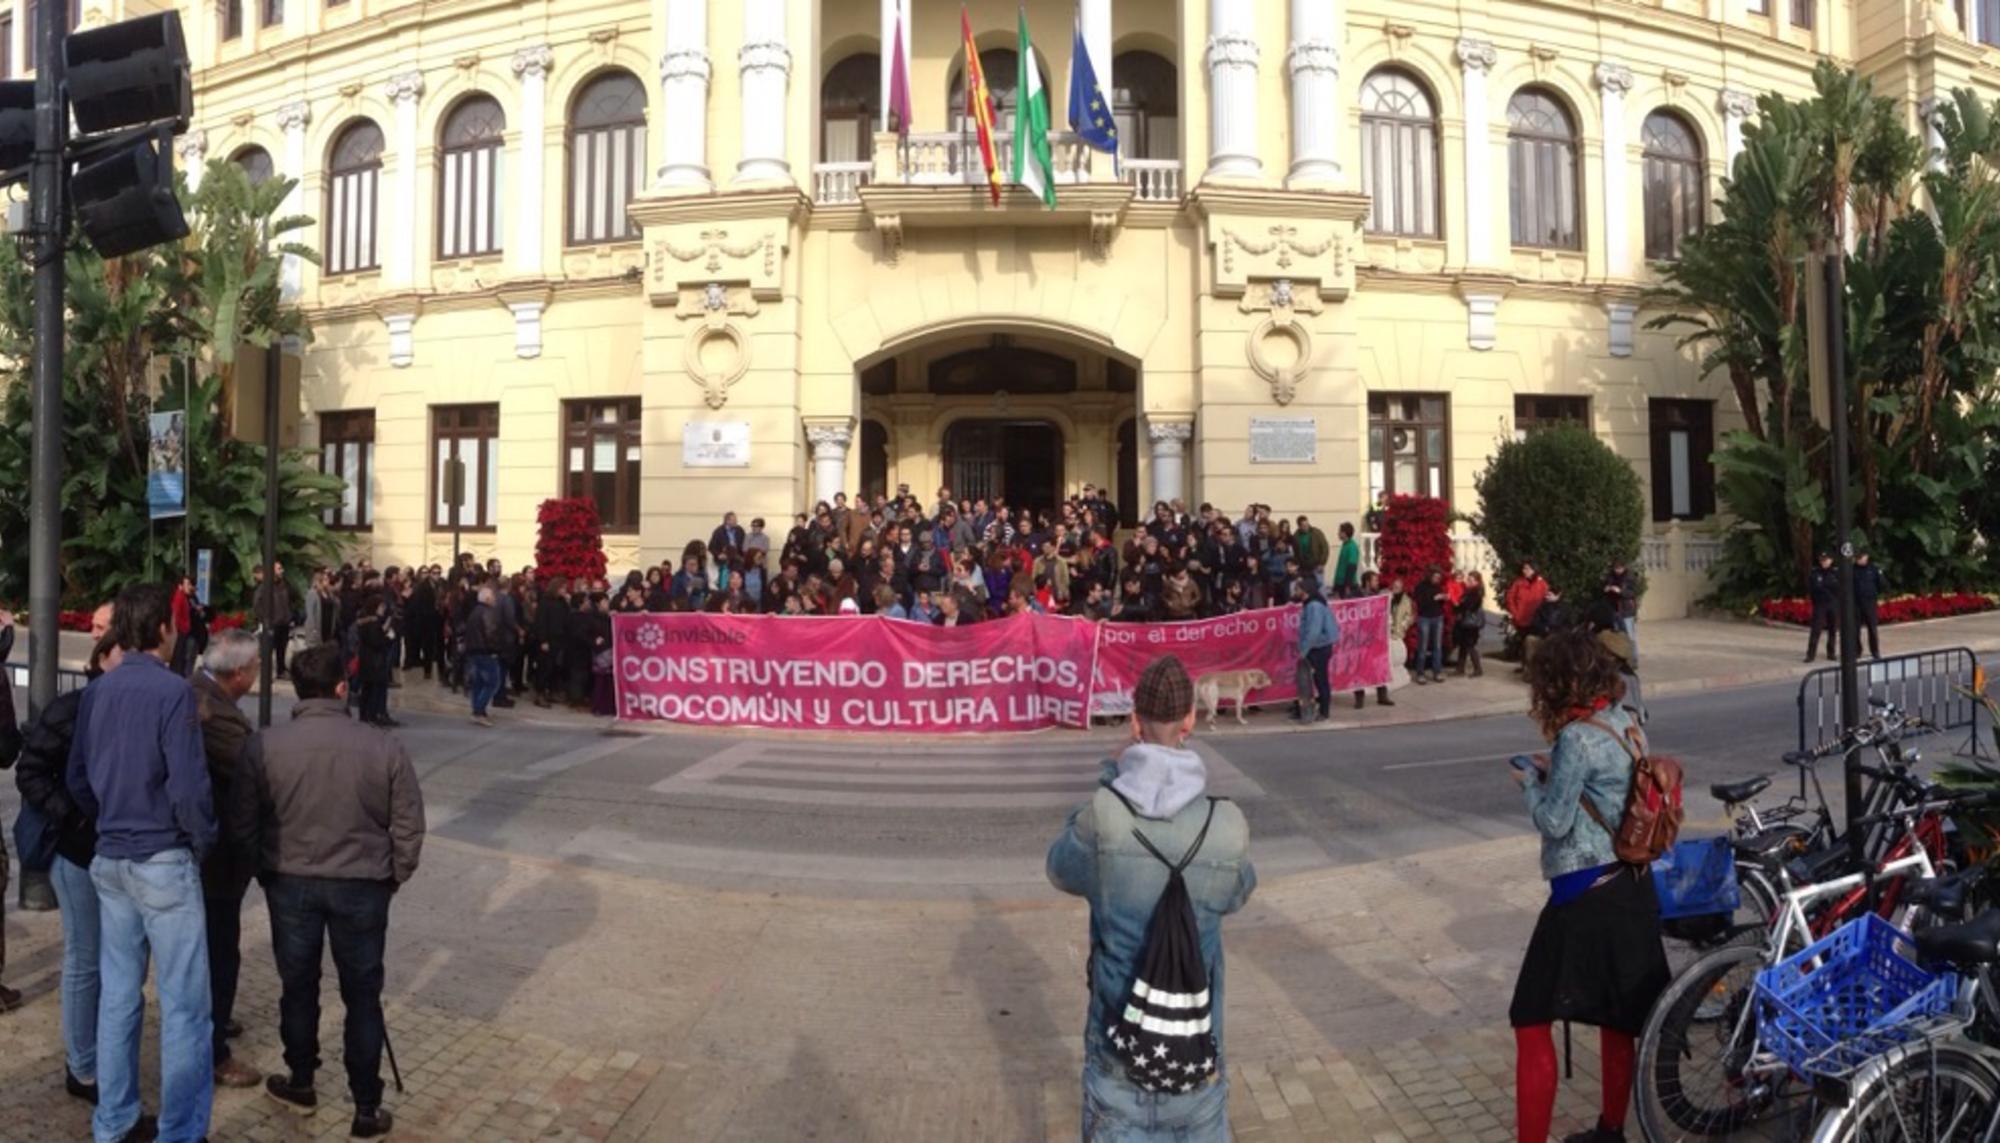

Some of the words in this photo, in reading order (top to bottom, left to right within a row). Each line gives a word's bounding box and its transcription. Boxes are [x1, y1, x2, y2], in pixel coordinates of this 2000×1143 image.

[1147, 626, 1166, 643] el
[1175, 615, 1259, 643] derecho
[1265, 615, 1277, 630] a
[622, 655, 887, 688] CONSTRUYENDO
[903, 655, 1084, 693] DERECHOS,
[624, 691, 803, 722] PROCOMÚN
[841, 697, 999, 725] CULTURA
